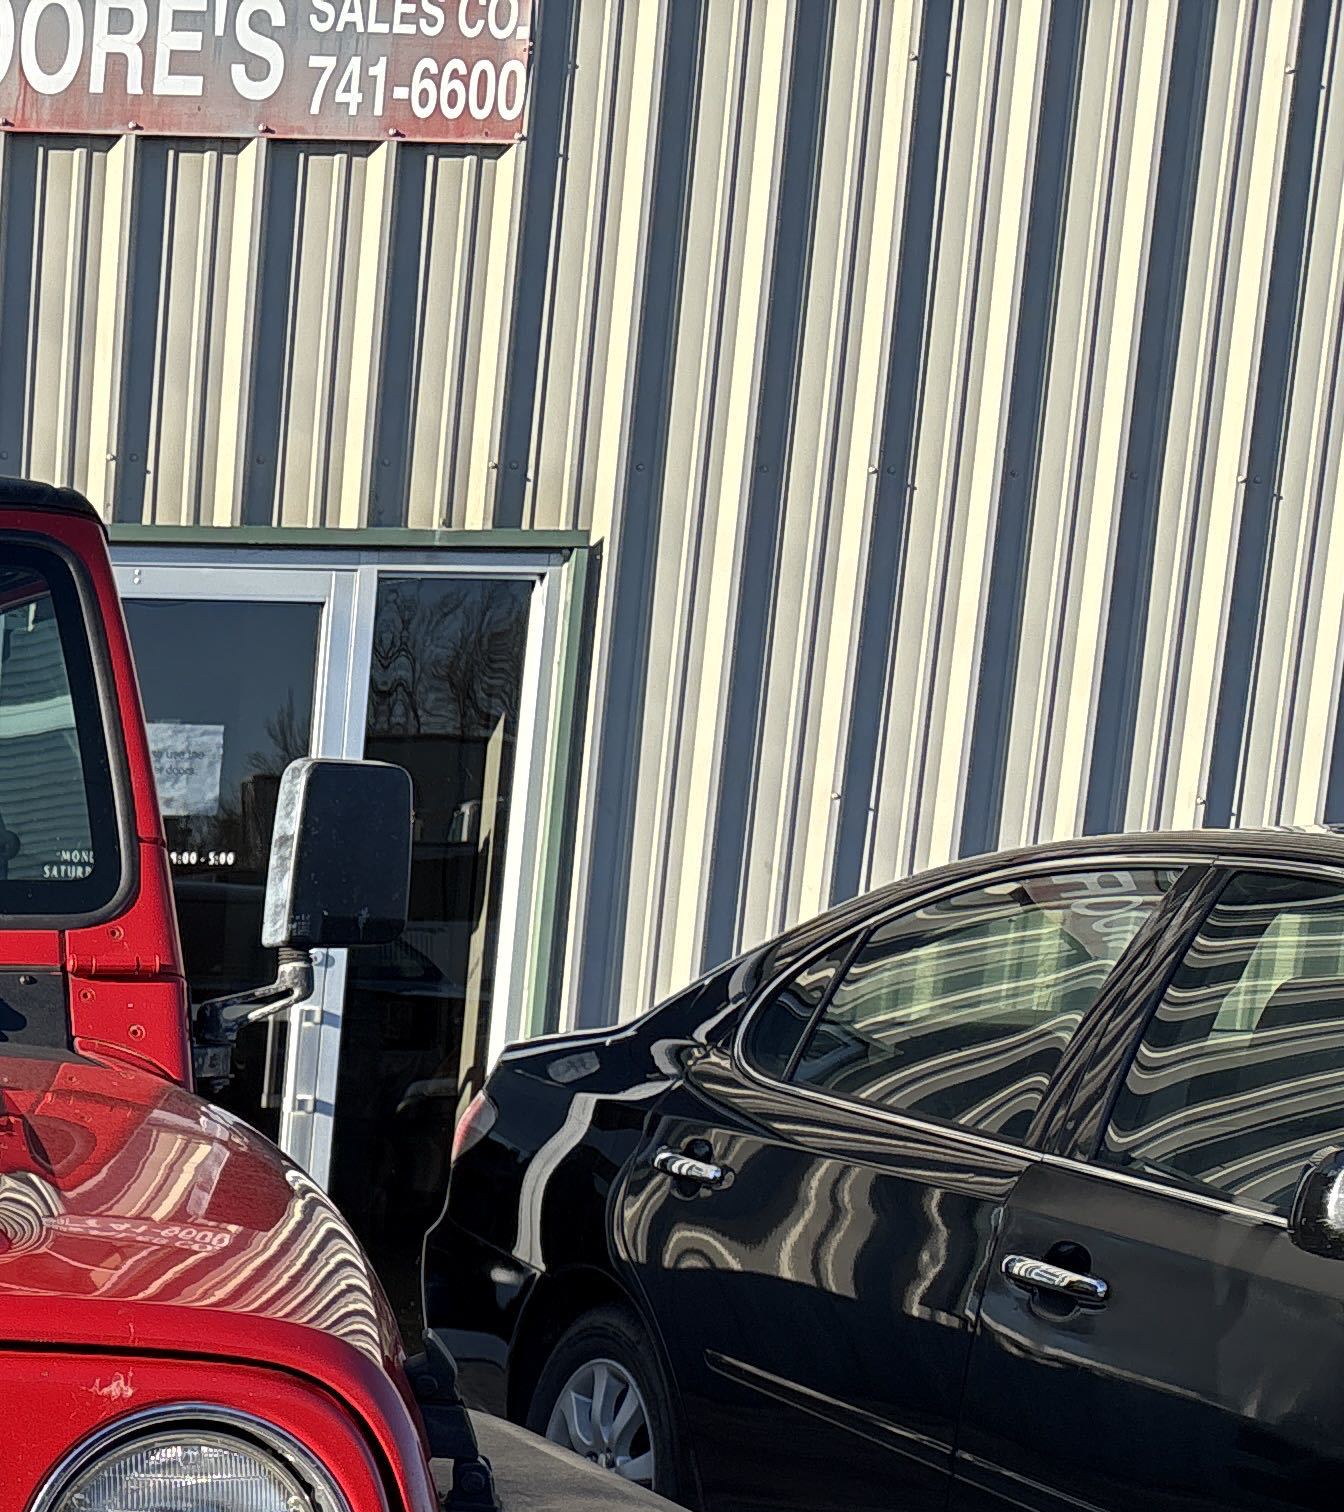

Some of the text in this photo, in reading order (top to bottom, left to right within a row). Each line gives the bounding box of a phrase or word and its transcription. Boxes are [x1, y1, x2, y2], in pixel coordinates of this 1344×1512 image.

[309, 0, 529, 40] SALES CO.
[308, 55, 527, 121] 741-6600
[170, 851, 197, 865] 9:00
[208, 851, 235, 866] 5:00
